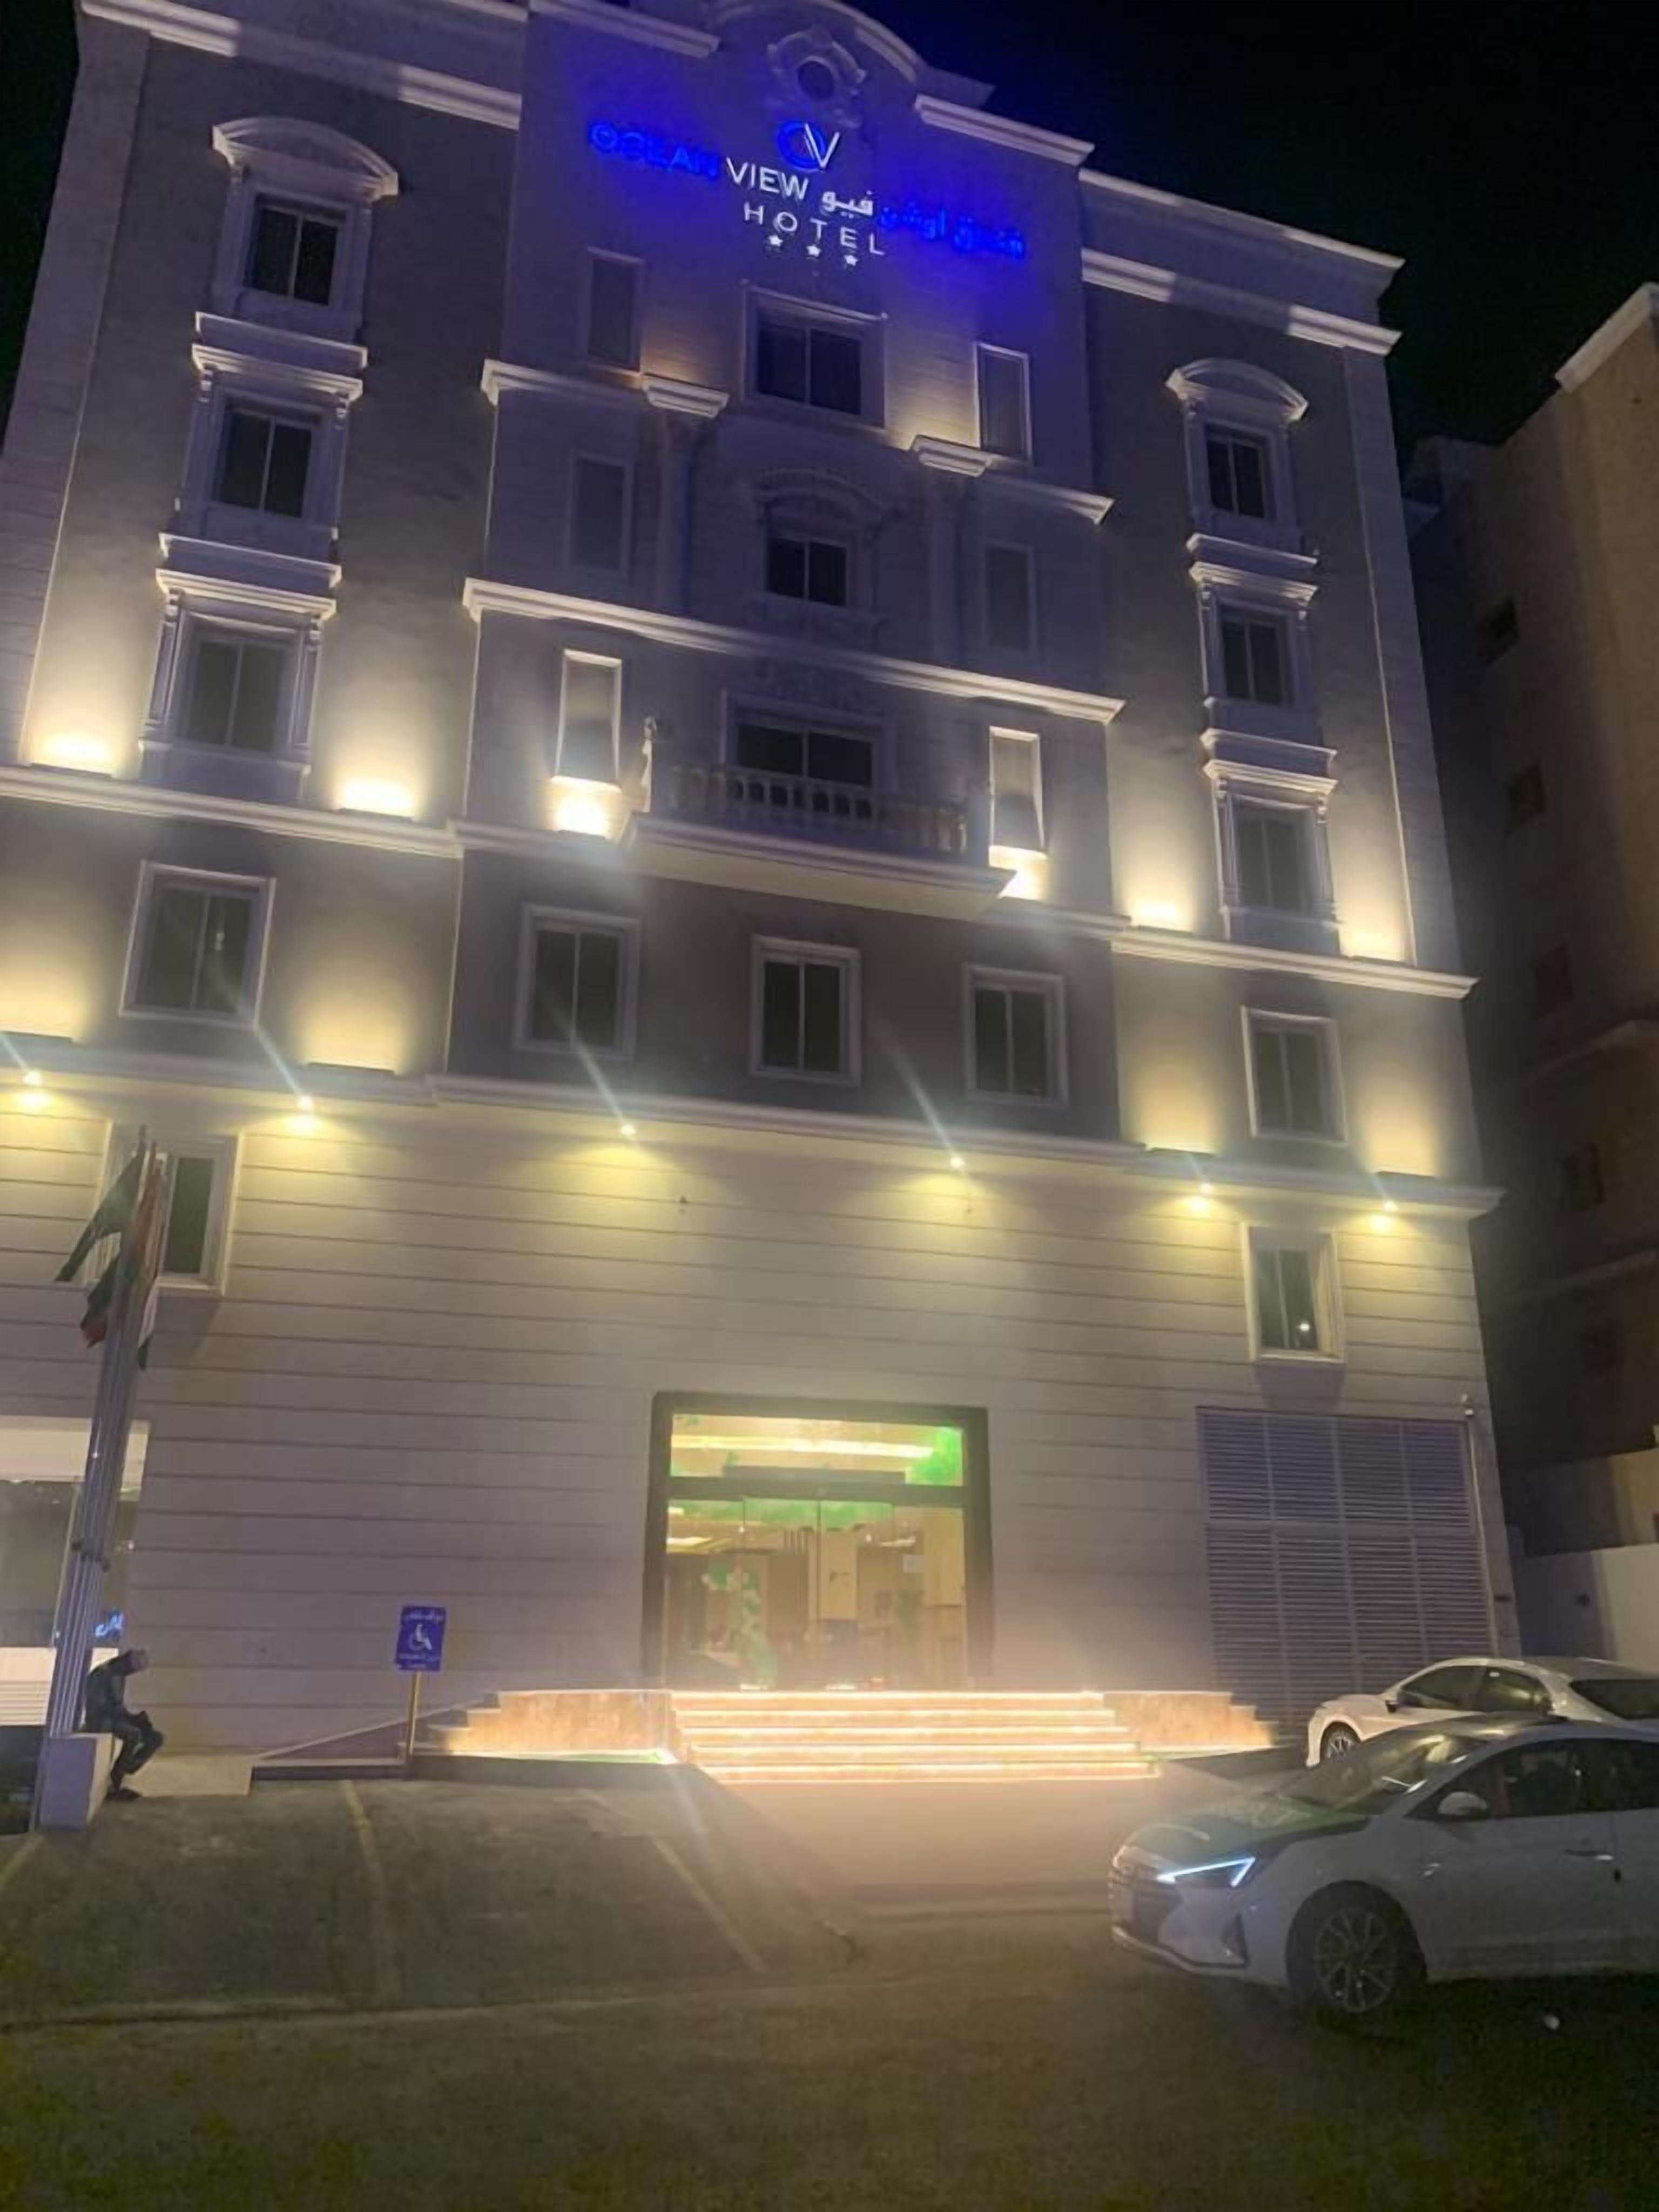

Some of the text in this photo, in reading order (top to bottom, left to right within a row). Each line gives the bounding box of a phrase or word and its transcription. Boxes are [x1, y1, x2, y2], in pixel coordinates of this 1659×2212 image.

[726, 157, 809, 200] VIEW
[822, 191, 873, 219] فيو
[744, 202, 885, 255] HOTEL
